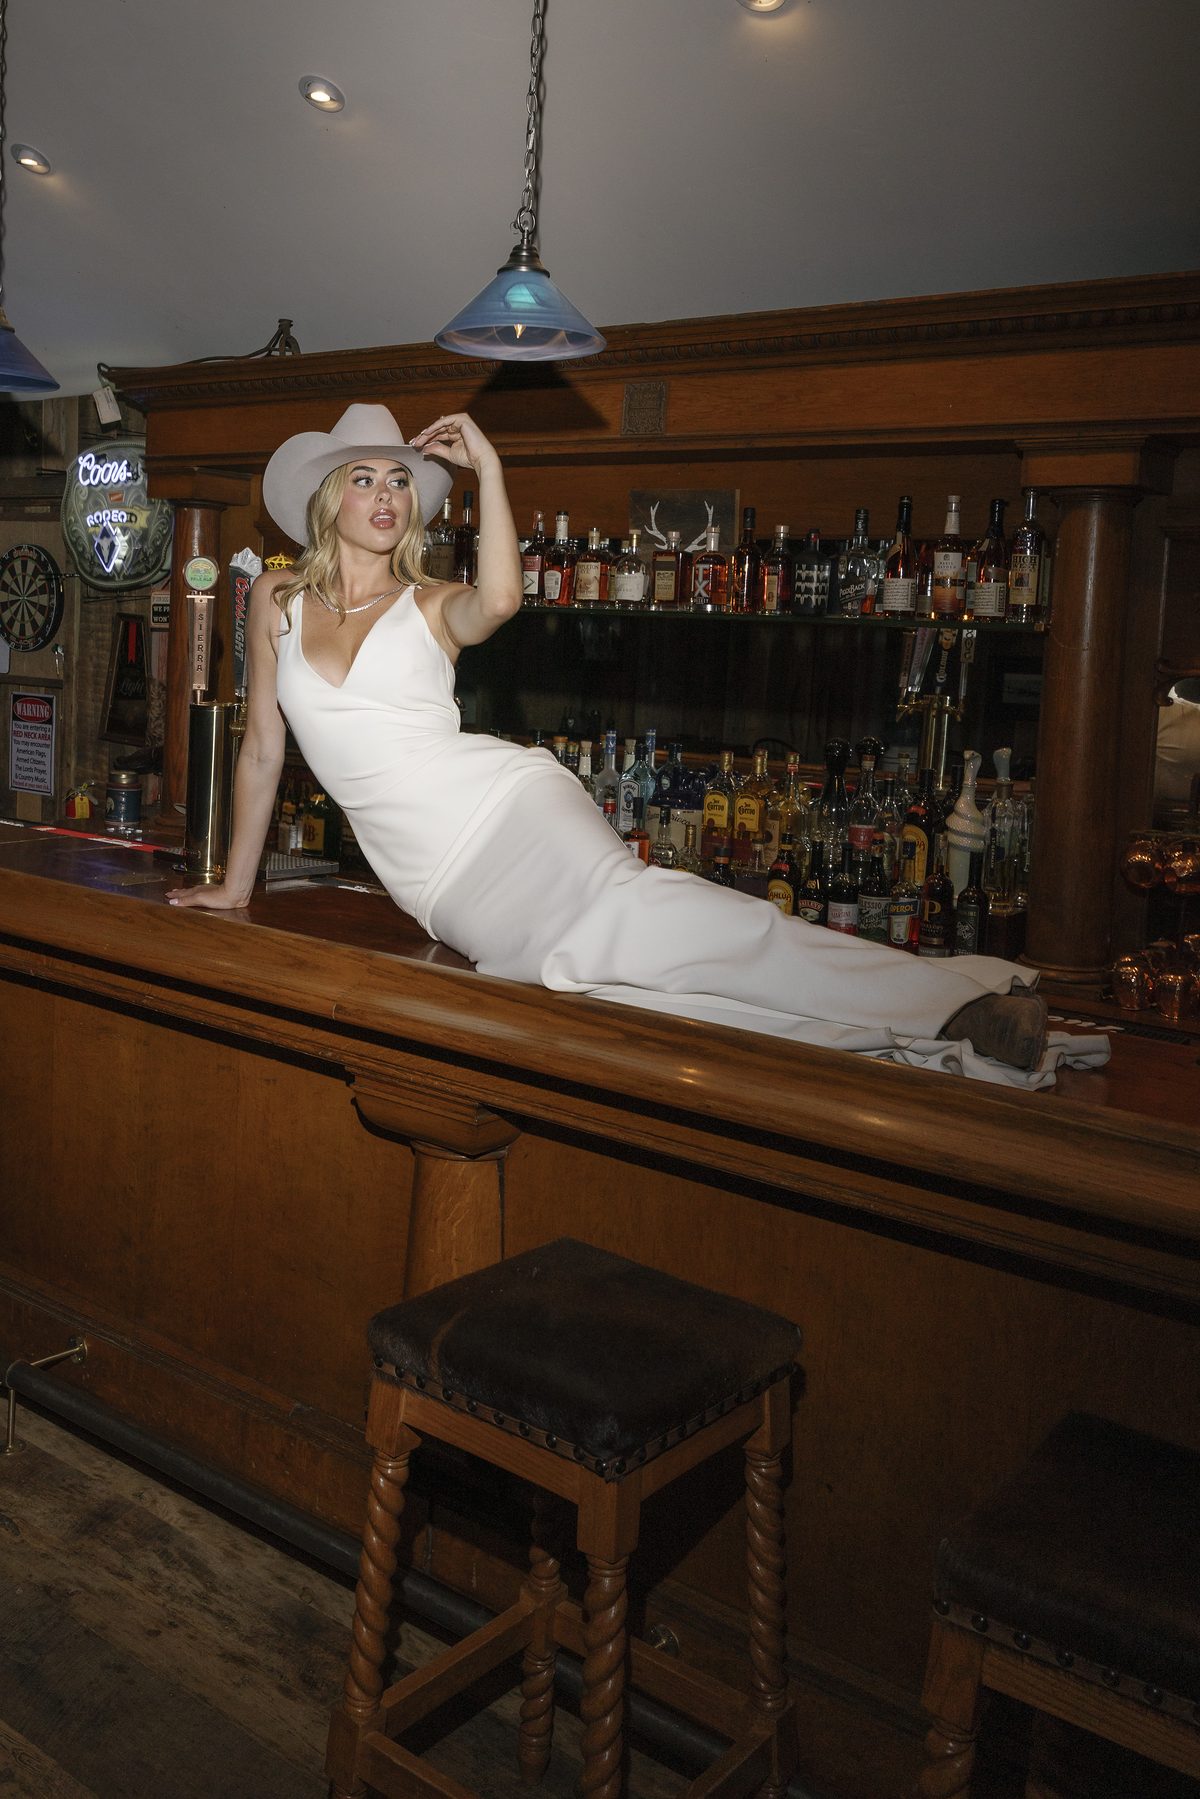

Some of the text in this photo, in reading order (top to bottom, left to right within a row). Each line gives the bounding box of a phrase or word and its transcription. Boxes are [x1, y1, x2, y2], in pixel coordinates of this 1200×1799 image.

[78, 453, 132, 486] Coors
[16, 702, 50, 718] WARNING
[30, 725, 47, 733] entering
[24, 731, 37, 739] NECK
[38, 733, 51, 741] AREA
